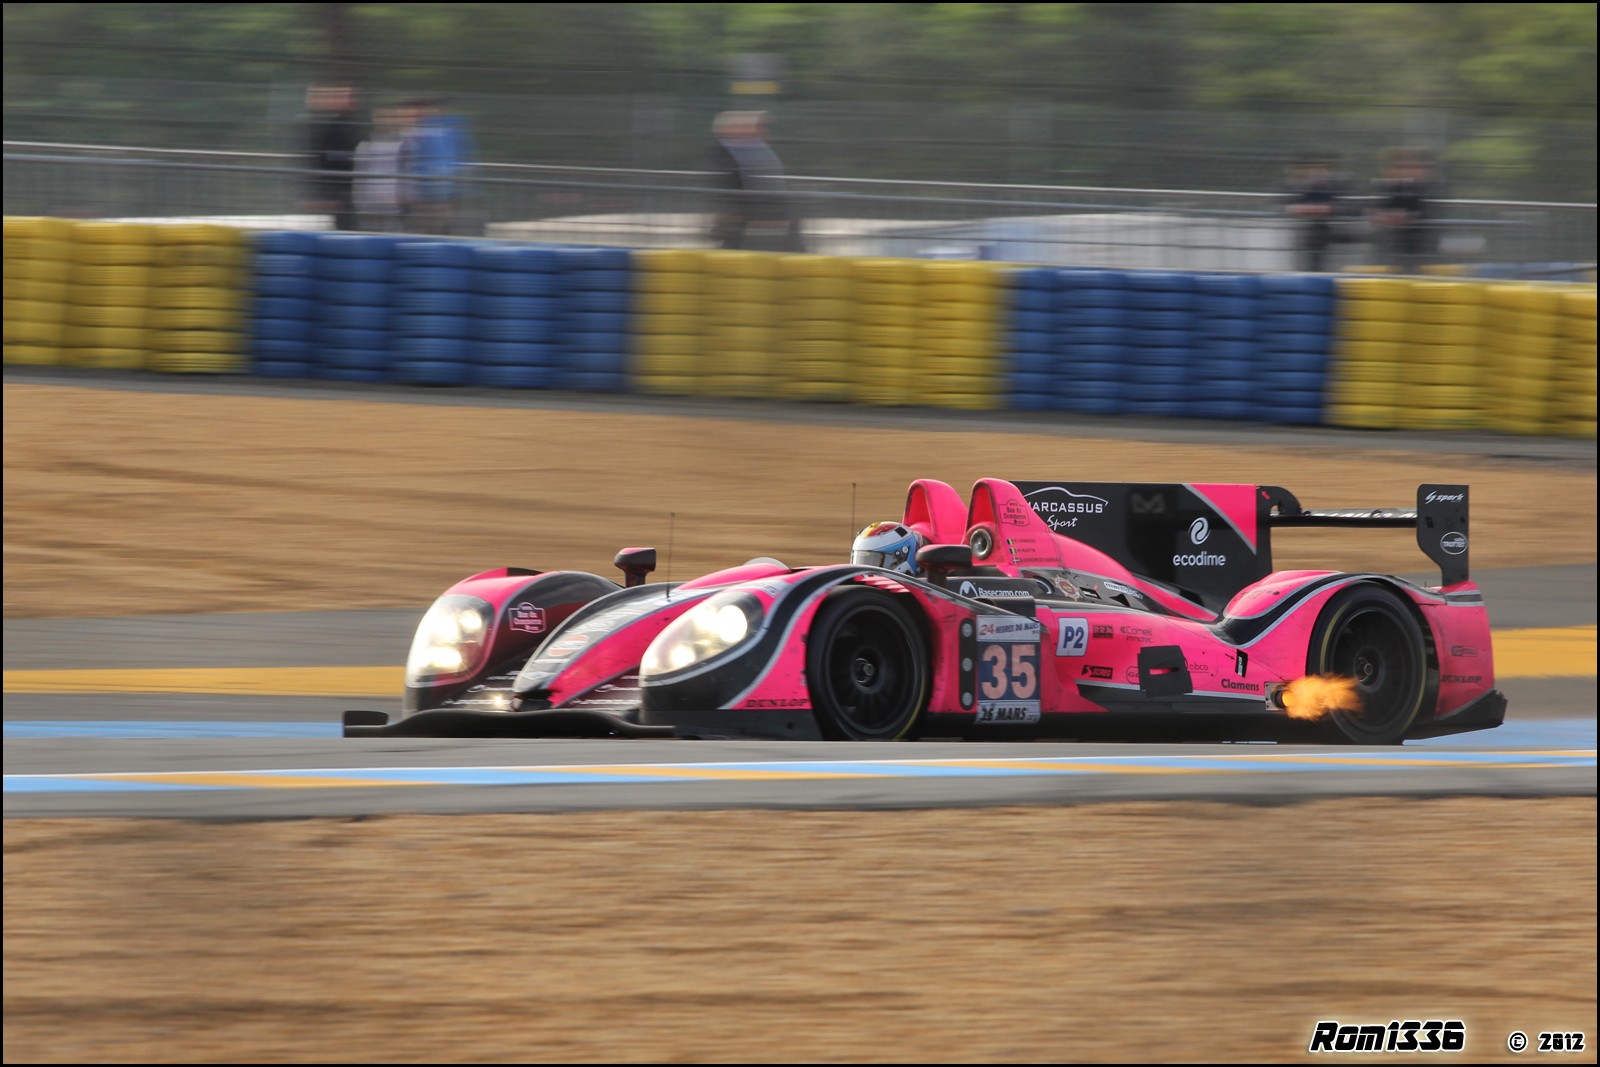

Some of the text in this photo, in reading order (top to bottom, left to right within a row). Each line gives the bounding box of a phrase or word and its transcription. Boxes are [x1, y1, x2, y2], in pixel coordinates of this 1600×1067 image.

[1028, 502, 1103, 513] ARCASSUS
[1047, 515, 1078, 531] Sport
[1173, 551, 1226, 566] ecodime
[980, 624, 994, 635] 24
[1063, 626, 1085, 649] P2
[982, 644, 1036, 699] 35
[1221, 678, 1259, 691] Clamens
